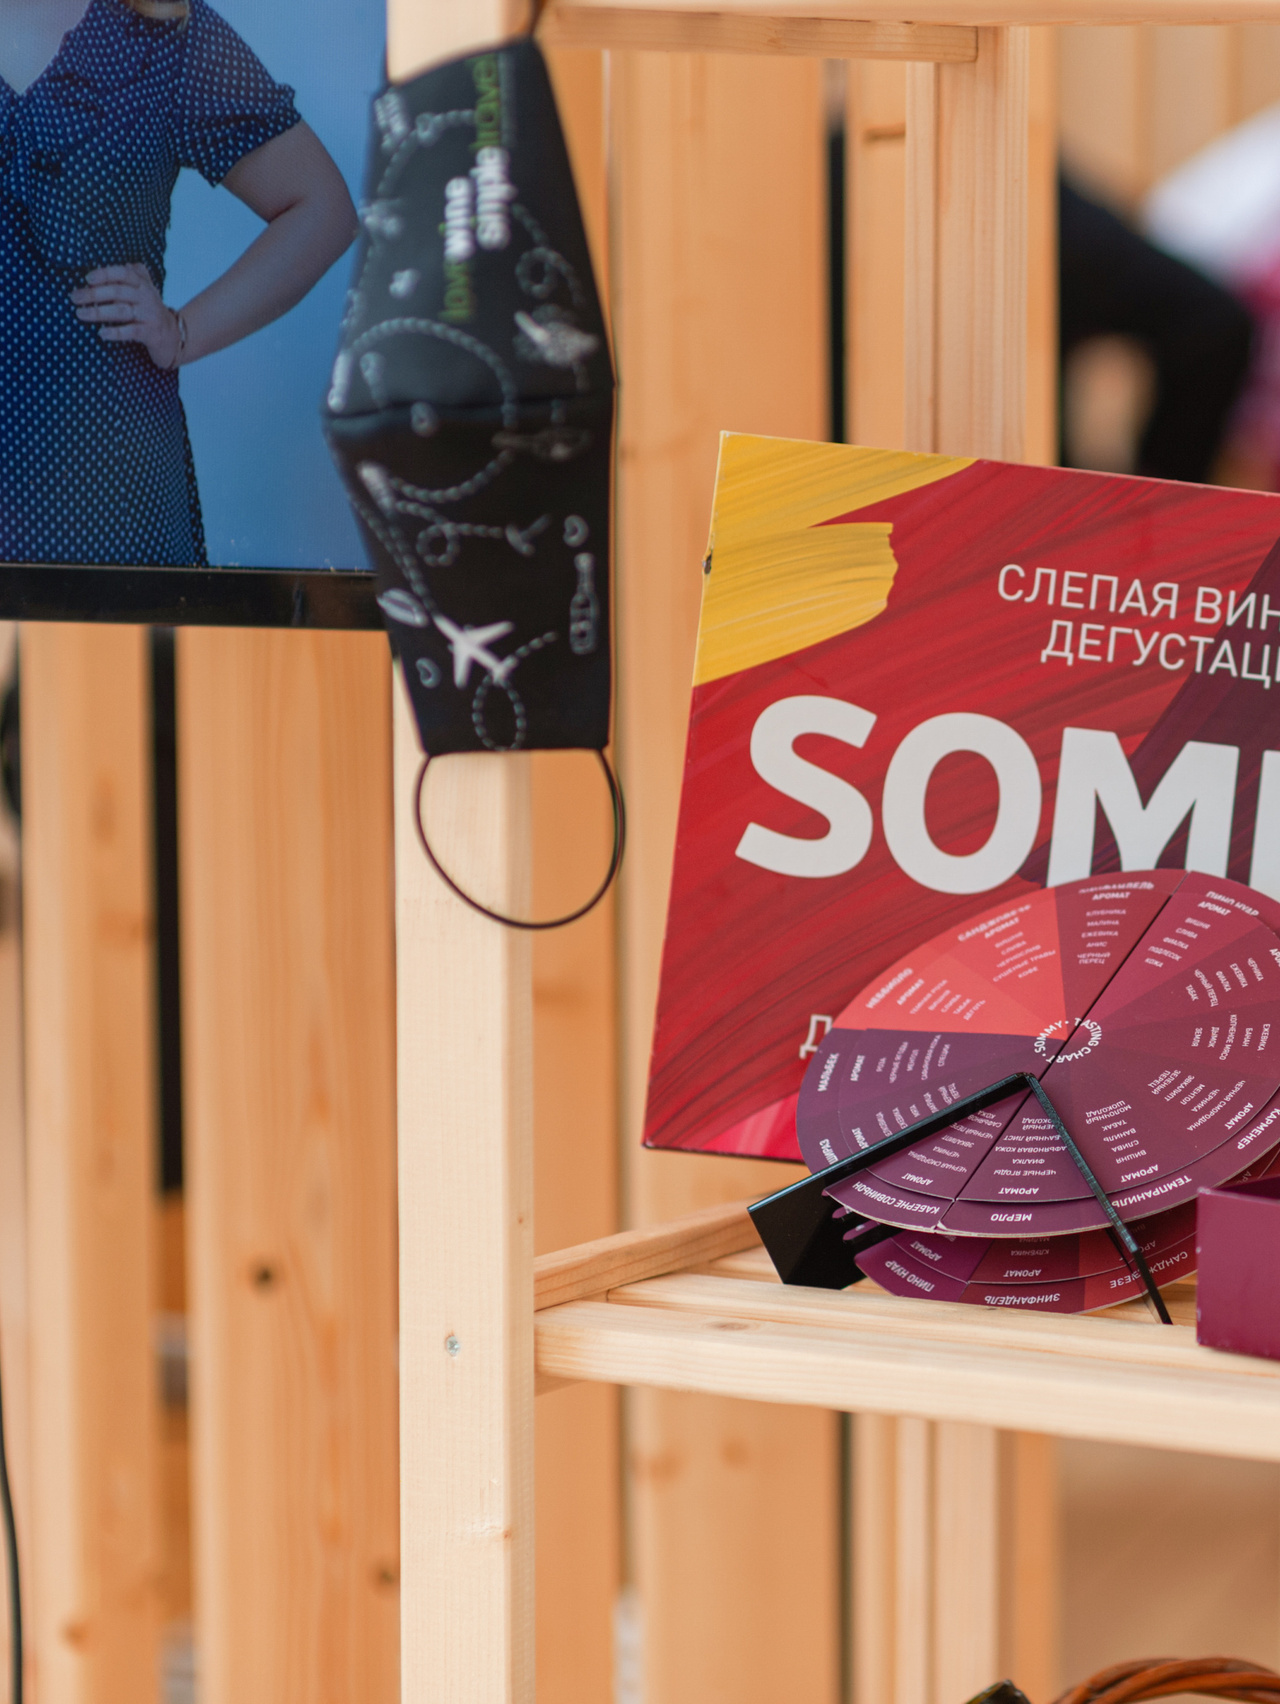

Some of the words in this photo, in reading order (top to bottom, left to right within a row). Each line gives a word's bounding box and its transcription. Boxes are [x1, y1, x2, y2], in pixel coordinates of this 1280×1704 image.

[997, 564, 1179, 619] СЛЕПАЯ
[1092, 892, 1130, 900] АРОМАТ
[1198, 901, 1231, 916] АРОМАТ
[984, 917, 1019, 938] АРОМАТ
[1230, 962, 1248, 988] ЕЖЕВИКА
[1247, 957, 1264, 981] ЧЕРНИКА
[1194, 969, 1213, 991] ЧЕРНЫЙ
[1206, 988, 1219, 1007] ПЕРЕЦ
[1216, 971, 1231, 992] ФИАЛКА
[1185, 984, 1199, 1001] ТАБАК
[1034, 1020, 1062, 1053] SOMMY
[1074, 1017, 1102, 1047] TASTING
[1191, 1027, 1203, 1047] ЗЕМЛЯ
[1226, 1014, 1238, 1043] КОПЧЕНОЕ
[1242, 1027, 1253, 1047] БАНАН
[1257, 1023, 1270, 1051] ЕЖЕВИКА
[1046, 1046, 1091, 1063] CHART
[1219, 1042, 1232, 1060] МЯСО
[818, 1053, 839, 1091] МАЛЬБЕК
[851, 1055, 865, 1081] АРОМАТ
[1147, 1070, 1171, 1088] ПЕРЕЦ
[1152, 1069, 1181, 1094] ЗЕЛЕНЫЙ
[1164, 1075, 1194, 1102] ЭВКАЛИПТ
[1180, 1083, 1206, 1105] МЕНТОЛ
[1191, 1088, 1220, 1112] ЧЕРНИКА
[1223, 1080, 1246, 1102] ЧЕРНАЯ
[1085, 1100, 1126, 1118] ШОКОЛАД
[1085, 1104, 1132, 1124] МОЛОЧНЫЙ
[1186, 1100, 1227, 1132] СМОРОДИНА
[1224, 1102, 1253, 1130] АРОМАТ
[950, 1122, 967, 1133] ПЕРЕ
[967, 1114, 1003, 1128] САФЬЯНОВ
[1101, 1119, 1127, 1131] ТАБАК
[852, 1127, 870, 1149] АРОМАТ
[941, 1134, 975, 1148] ЭВКАЛИПТ
[965, 1127, 994, 1139] ЧЕРНЫЙ
[1103, 1128, 1137, 1142] ВАНИЛЬ
[819, 1138, 838, 1165] ШИРАЗ
[932, 1145, 960, 1158] ЧЕРНИКА
[1111, 1139, 1140, 1152] СЛИВА
[908, 1150, 942, 1168] СМОРОДИНА
[1115, 1149, 1147, 1164] ВИШНЯ
[940, 1161, 968, 1173] ЧЕРНАЯ
[1120, 1164, 1159, 1183] АРОМАТ
[901, 1172, 934, 1186] АРОМАТ
[852, 1181, 896, 1206] СОВИНЬОН
[998, 1187, 1039, 1195] АРОМАТ
[1111, 1175, 1193, 1208] ТЕМПРАНИЛЬ
[894, 1199, 940, 1215] КАБЕРНЕ
[990, 1213, 1032, 1222] МЕРЛО
[910, 1241, 943, 1262] АРОМАТ
[885, 1260, 911, 1279] НУАР
[1003, 1269, 1042, 1278] АРОМАТ
[907, 1273, 935, 1292] ПИНО
[984, 1293, 1061, 1305] ЗИНФАНДЕЛЬ
